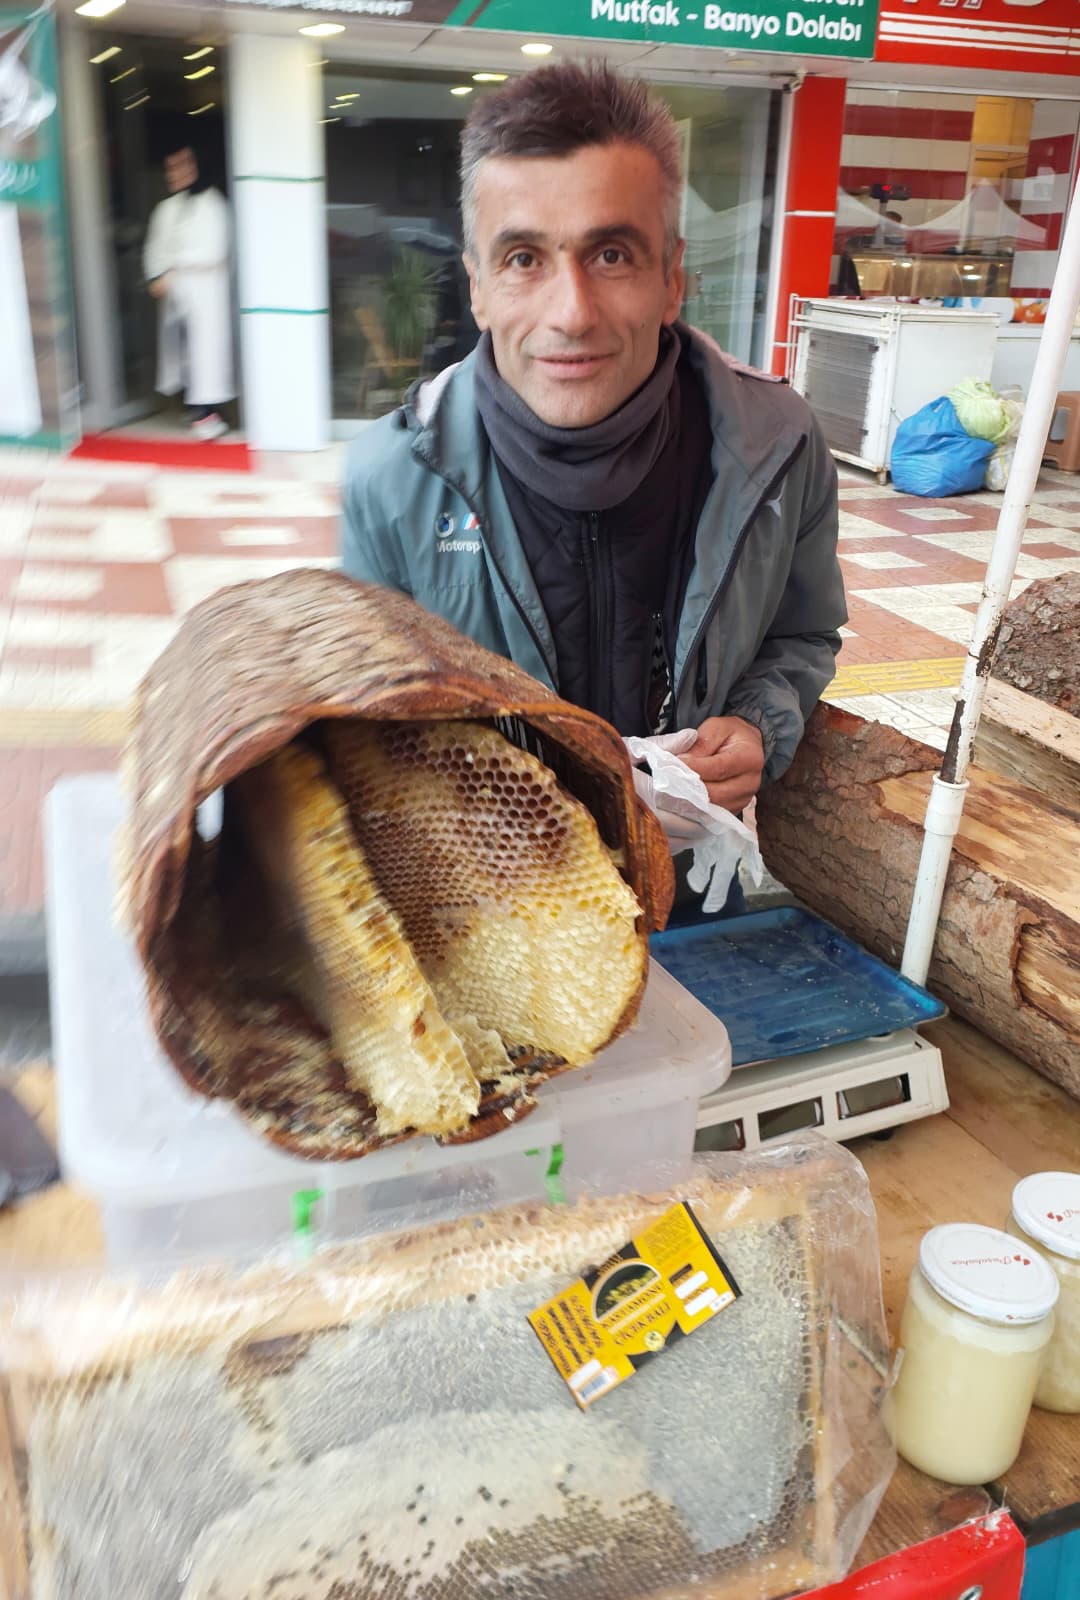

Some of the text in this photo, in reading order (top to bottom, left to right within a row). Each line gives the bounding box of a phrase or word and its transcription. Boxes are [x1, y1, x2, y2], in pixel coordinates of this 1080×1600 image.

[592, 0, 680, 27] Mutfak
[703, 4, 781, 39] Banyo
[785, 11, 862, 42] Dolabı
